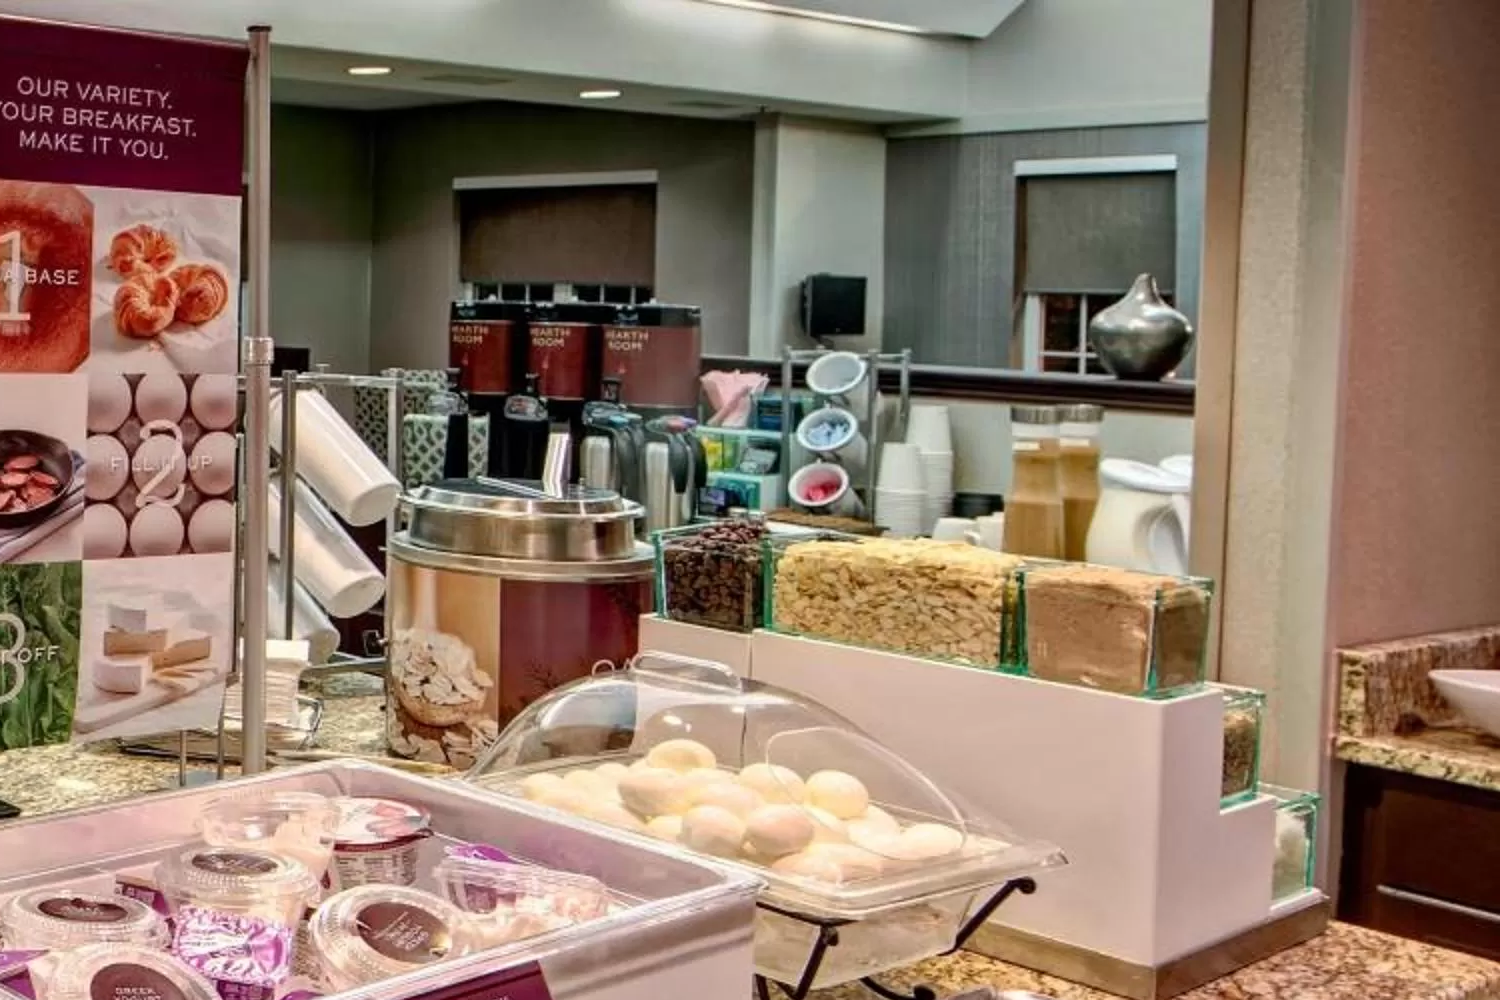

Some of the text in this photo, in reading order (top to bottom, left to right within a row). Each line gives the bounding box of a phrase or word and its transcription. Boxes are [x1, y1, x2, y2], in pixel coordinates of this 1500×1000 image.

[17, 75, 173, 110] OUR VARIETY.
[62, 107, 197, 138] BREAKFAST.
[19, 129, 169, 161] MAKE IT YOU.
[25, 268, 80, 286] BASE
[135, 419, 185, 508] 2
[17, 644, 61, 663] OFF
